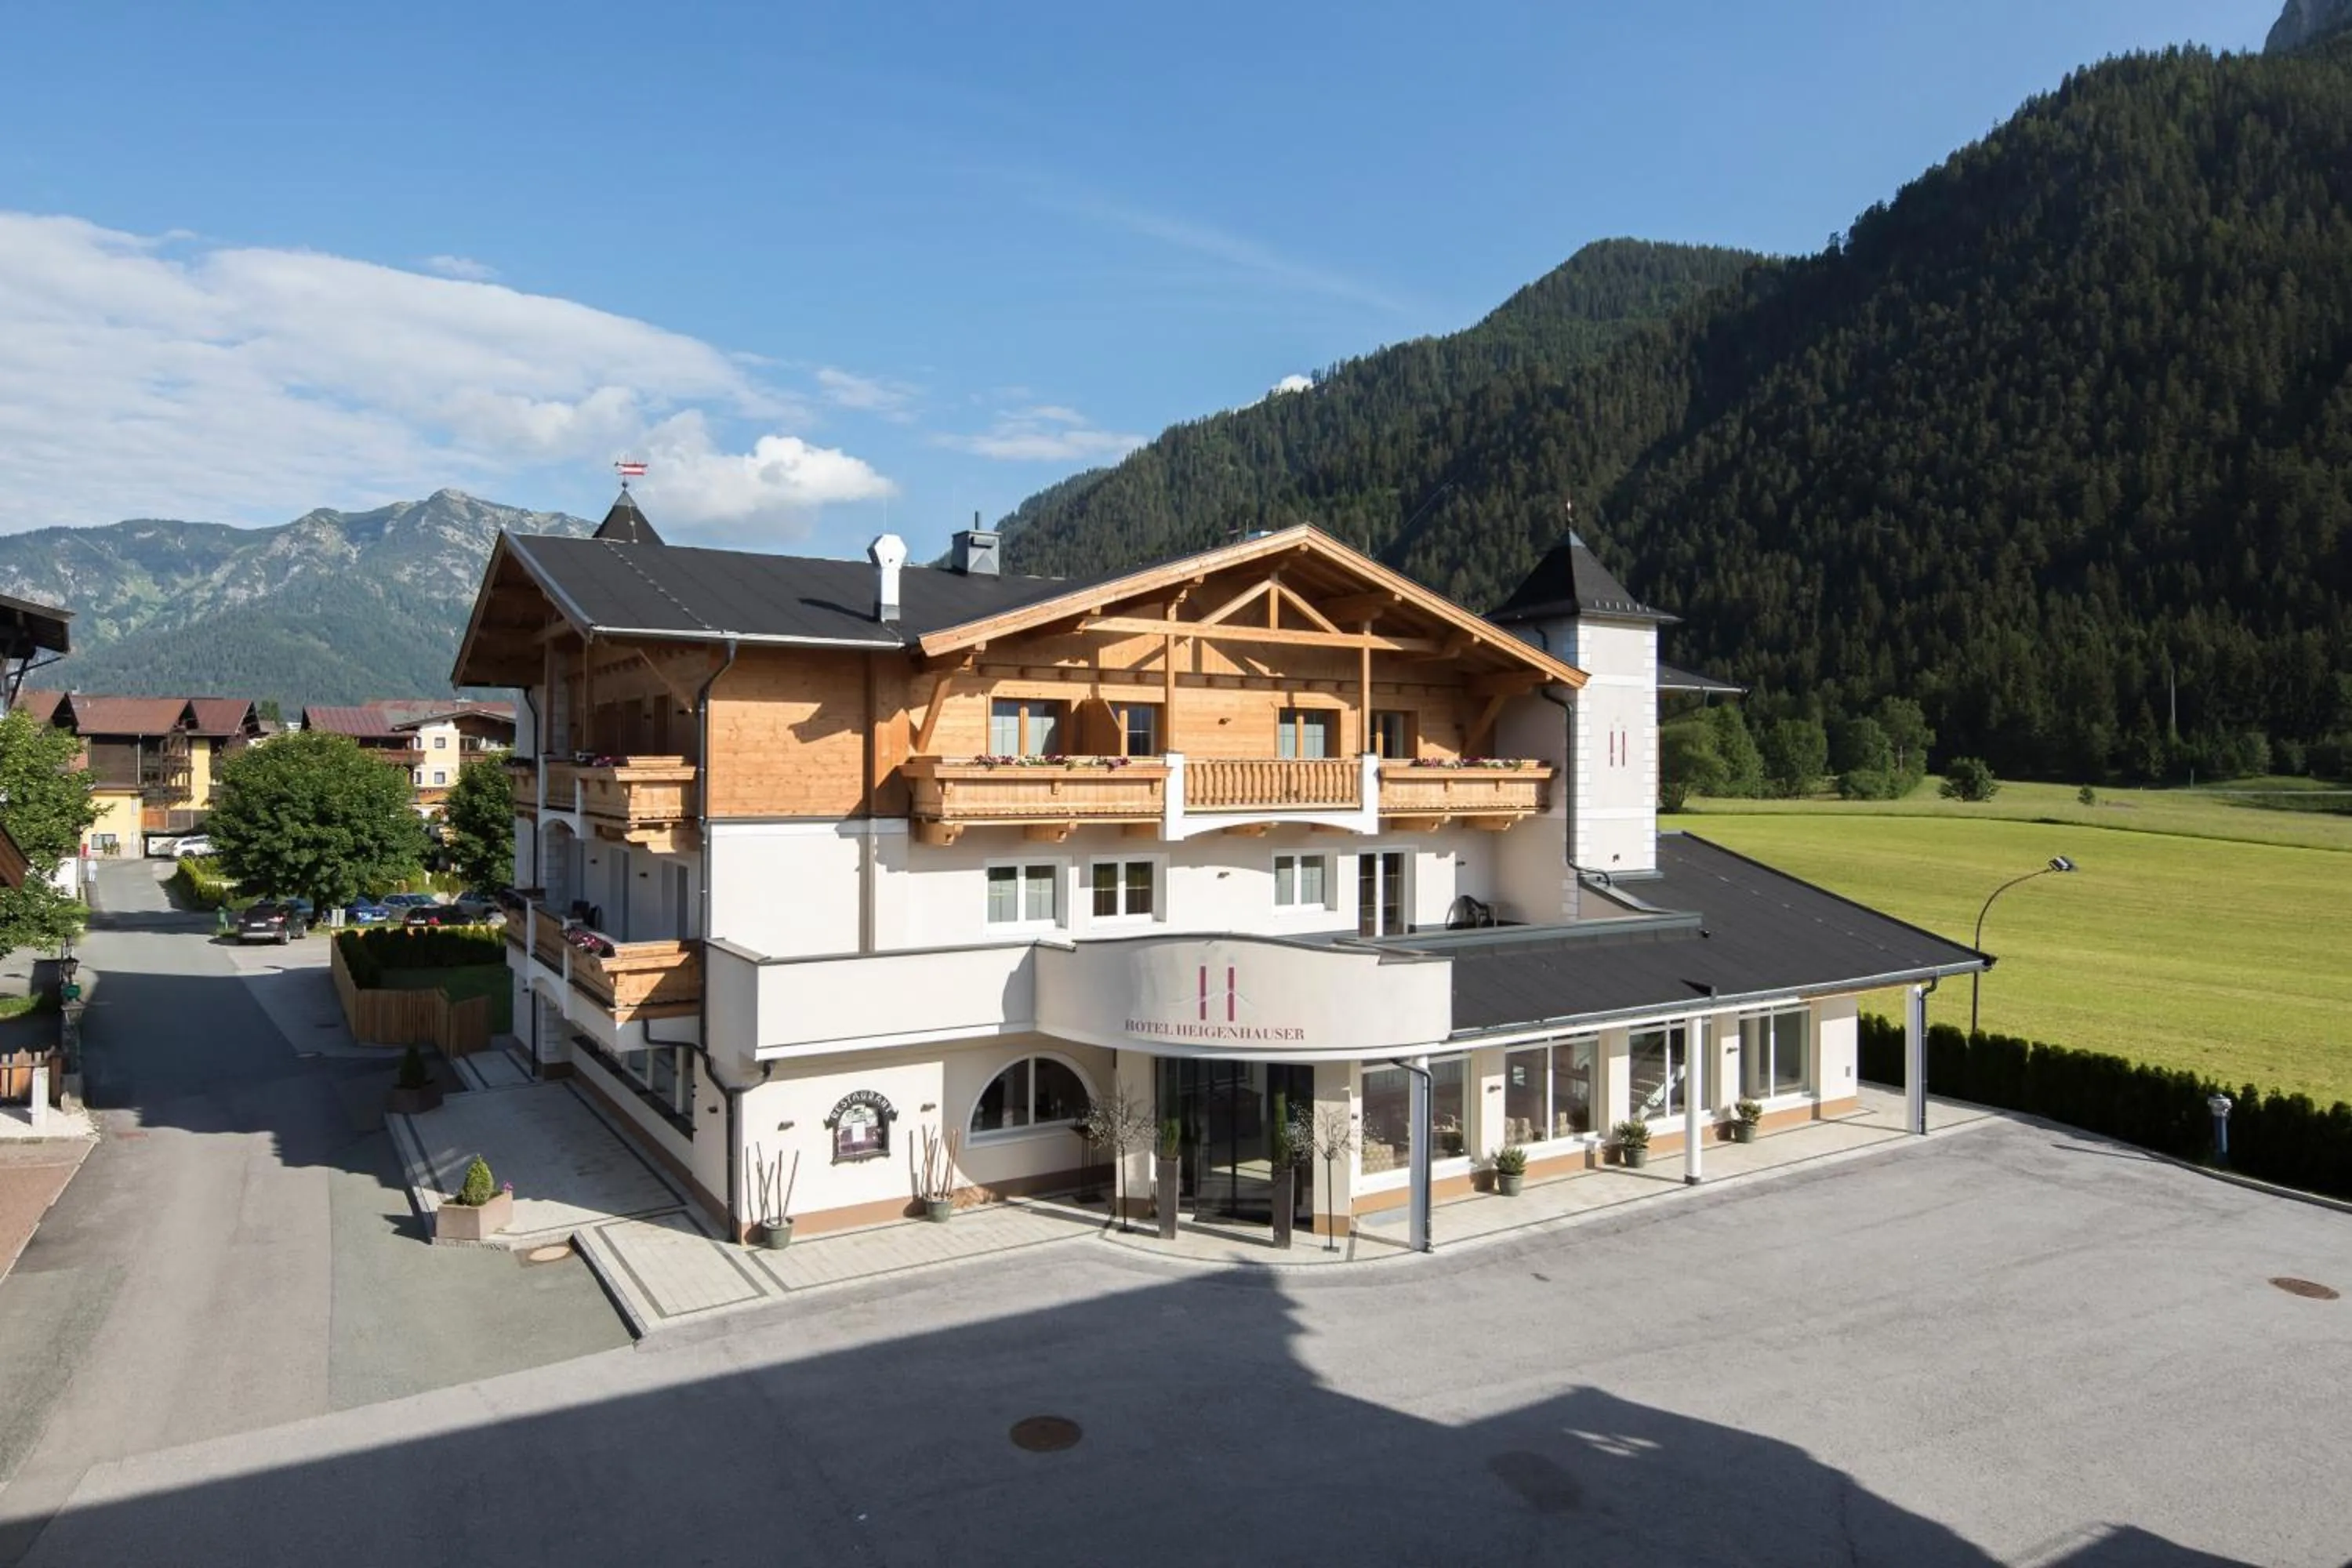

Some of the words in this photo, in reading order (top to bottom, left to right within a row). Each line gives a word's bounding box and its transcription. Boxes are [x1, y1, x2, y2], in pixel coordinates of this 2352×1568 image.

[1124, 1019, 1174, 1036] HOTEL
[1176, 1023, 1305, 1040] HEIGENHAUSER
[830, 1091, 893, 1119] RESTAURANT
